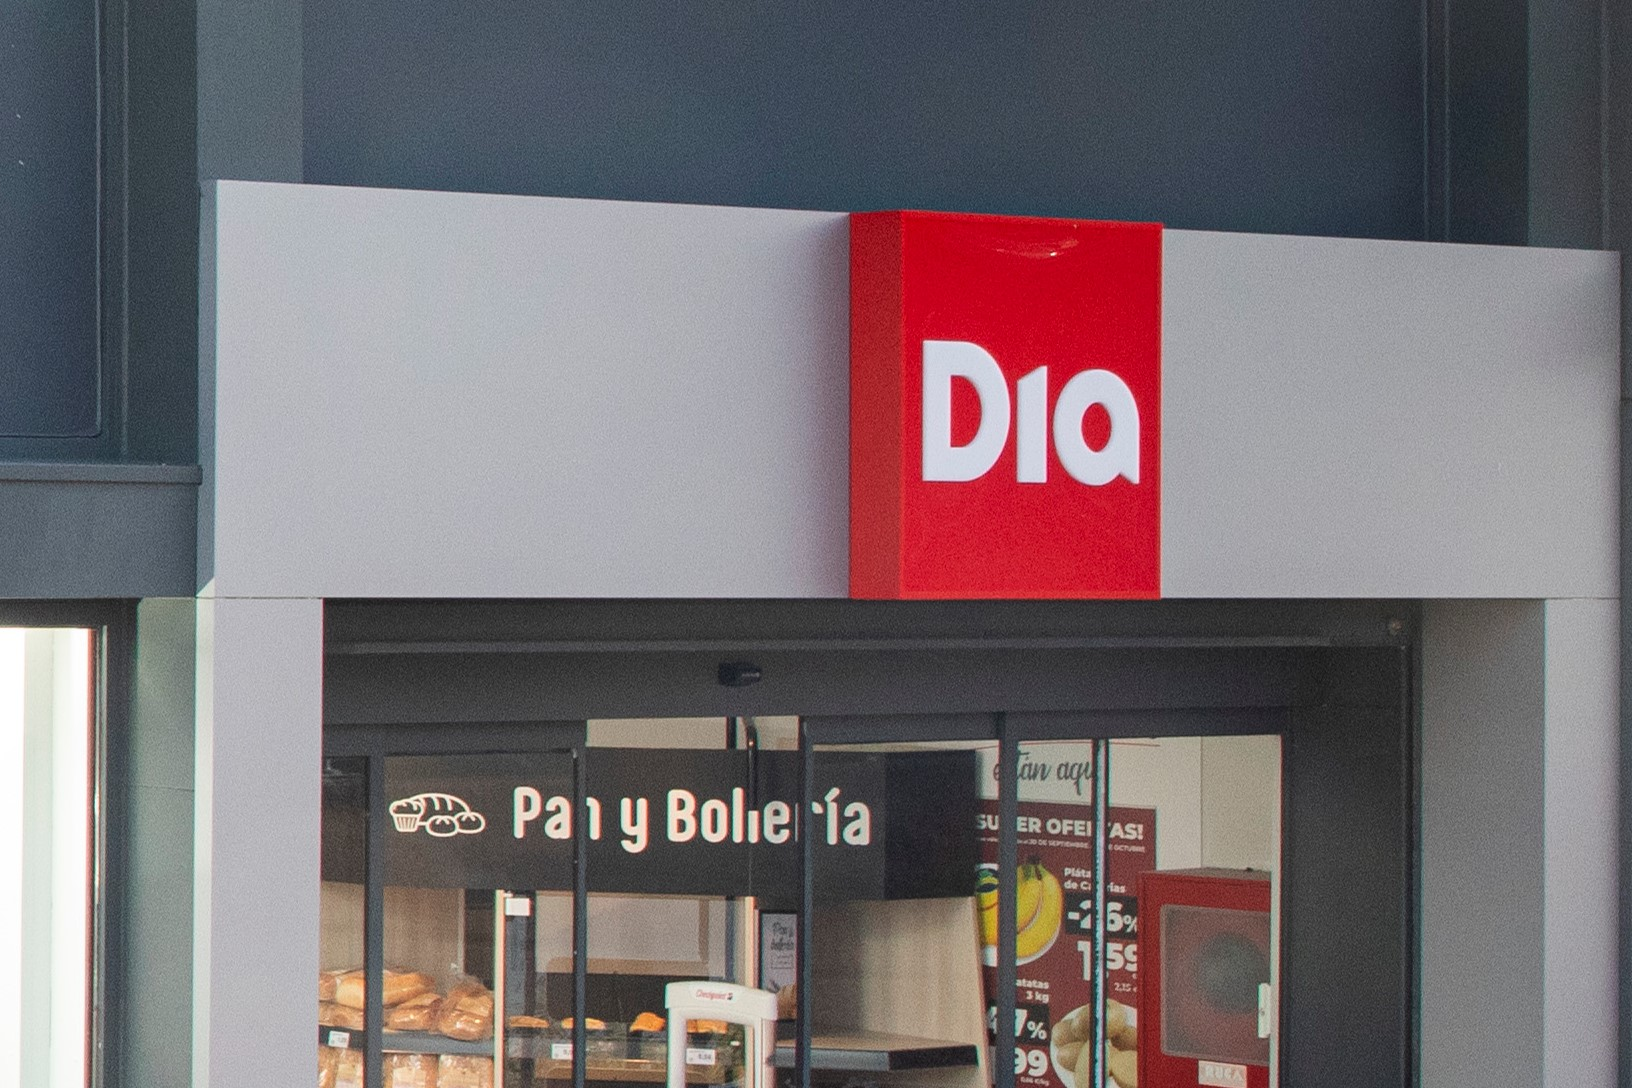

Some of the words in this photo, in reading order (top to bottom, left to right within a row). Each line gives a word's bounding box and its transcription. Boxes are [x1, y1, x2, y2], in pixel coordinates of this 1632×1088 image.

[1057, 761, 1093, 796] aqu
[513, 787, 601, 840] Pan
[620, 798, 648, 853] y
[976, 814, 1042, 834] SUER
[1046, 818, 1144, 840] OFEAS!
[1015, 979, 1049, 990] atatas
[1035, 992, 1049, 1004] kg
